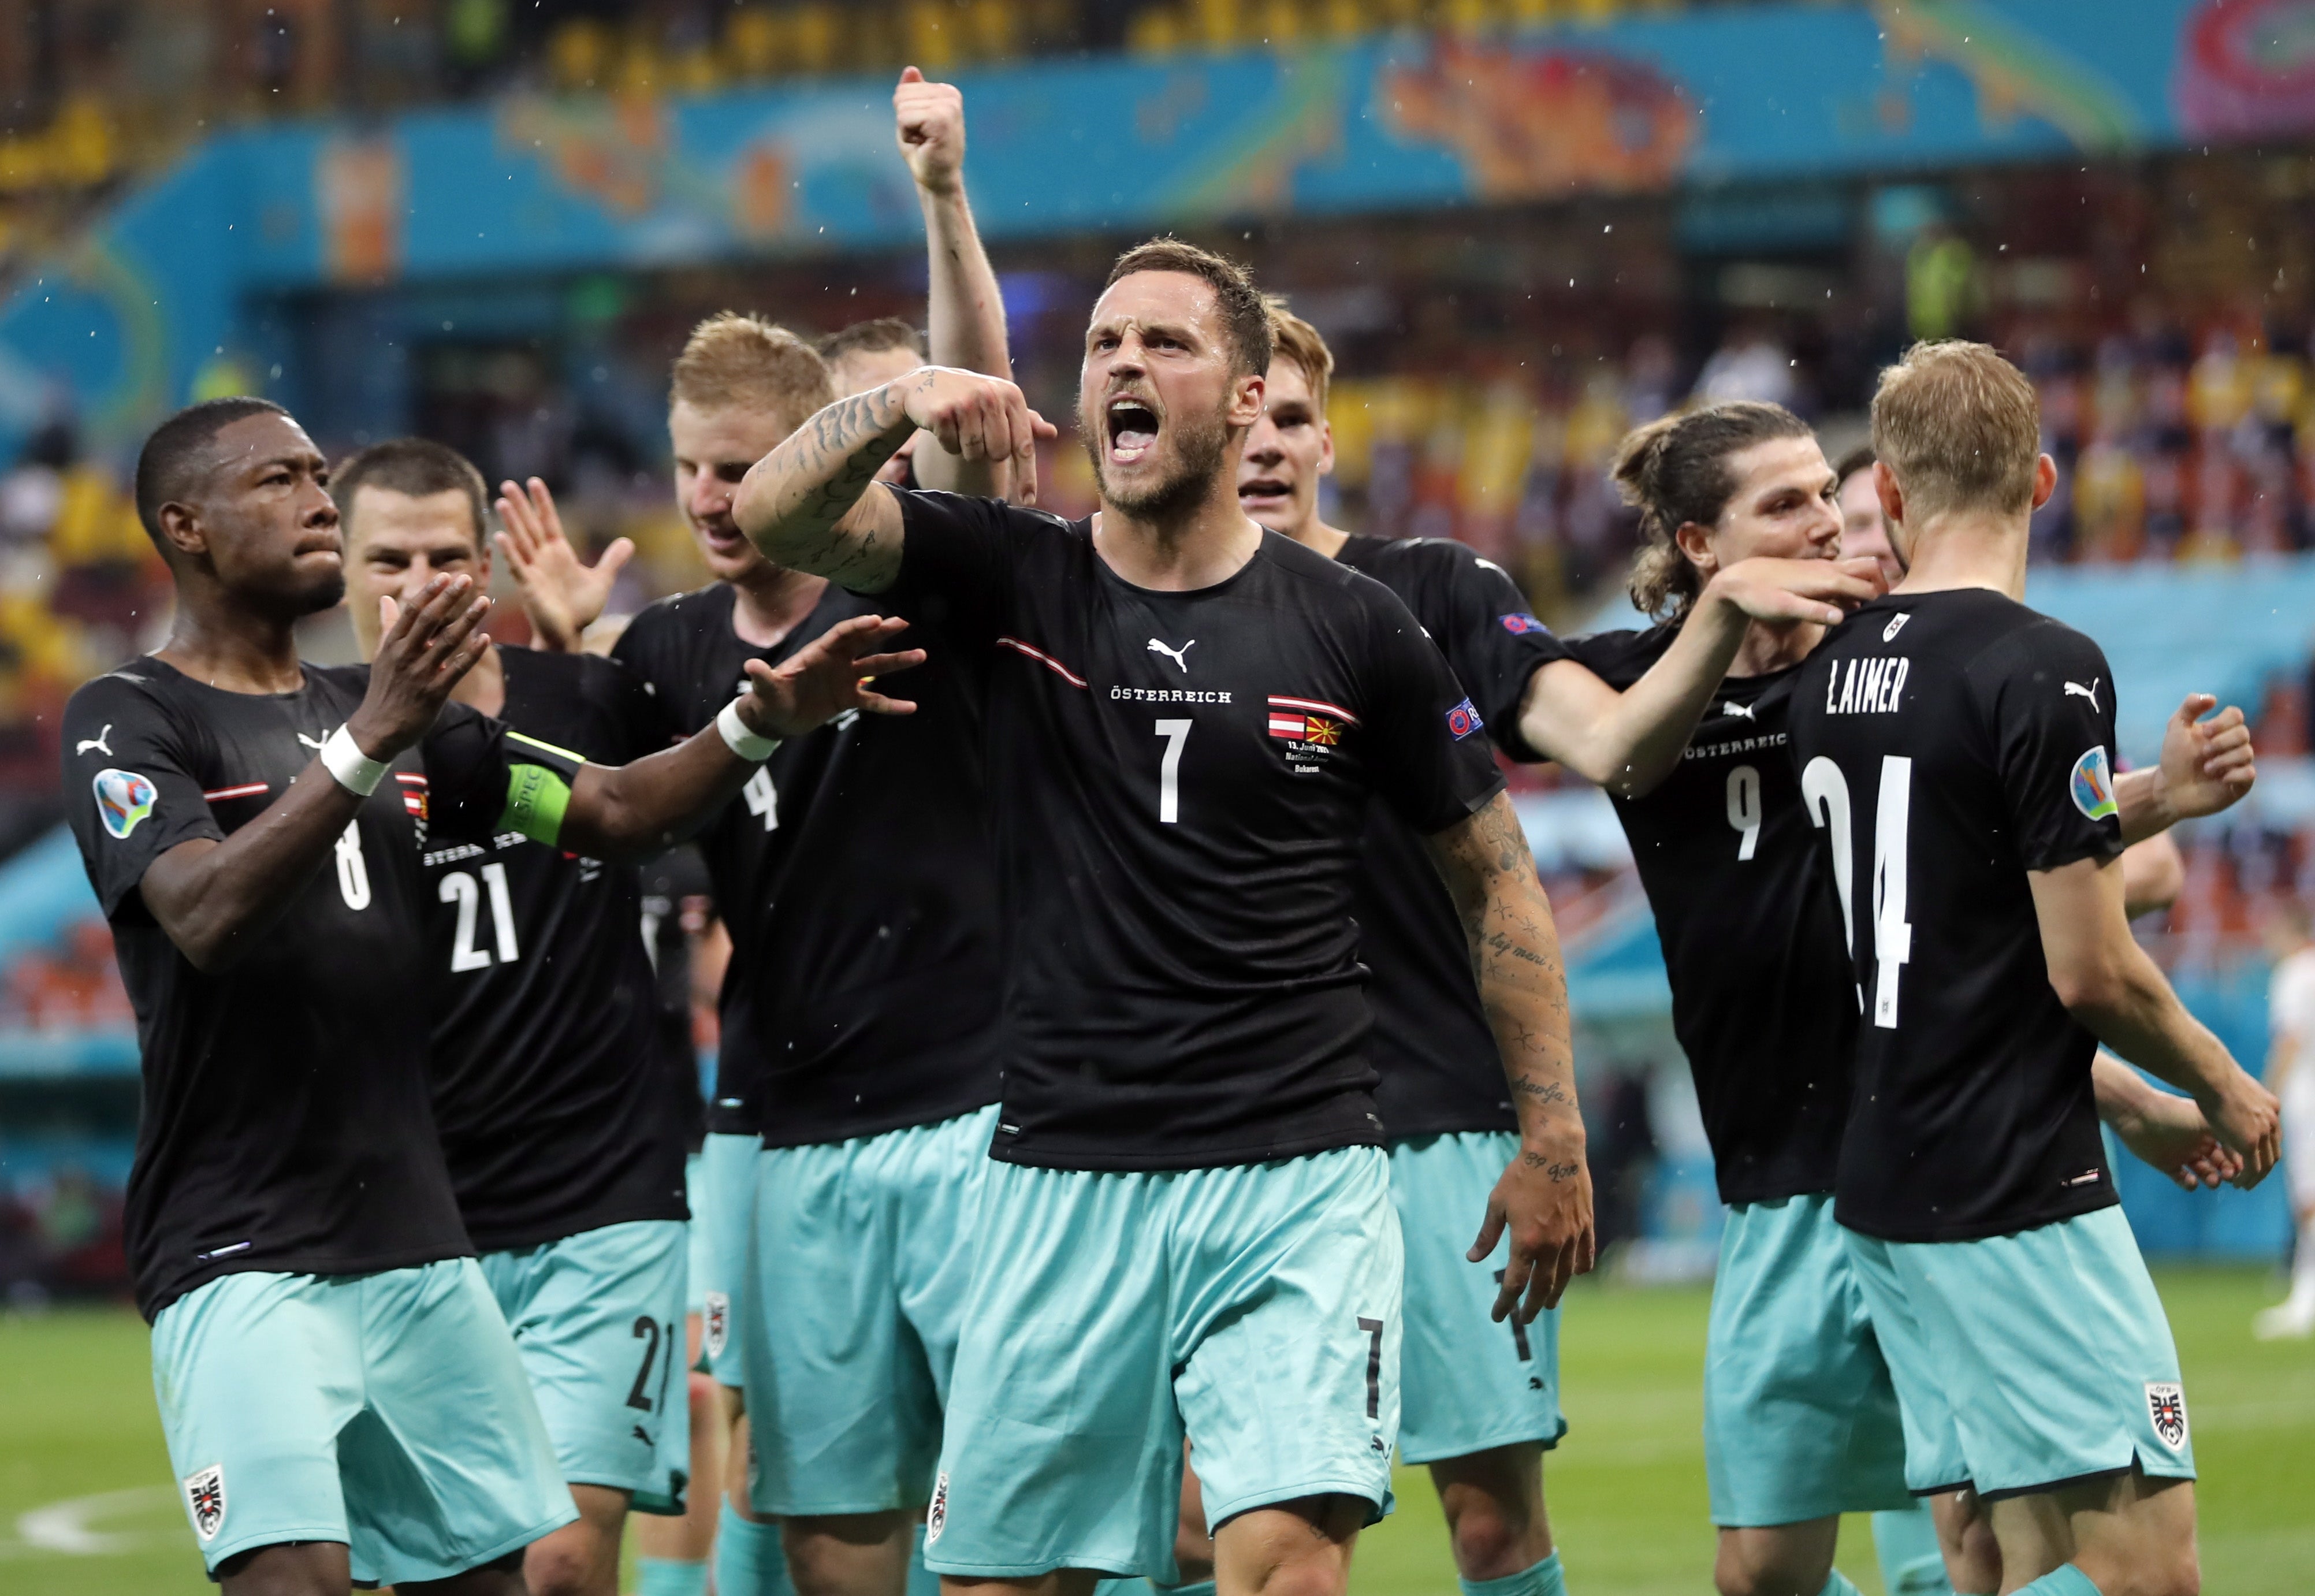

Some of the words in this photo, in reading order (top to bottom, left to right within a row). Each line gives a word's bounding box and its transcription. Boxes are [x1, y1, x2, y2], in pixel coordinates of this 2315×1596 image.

[1110, 685, 1231, 703] ÖSTERREICH
[1826, 657, 1909, 714] LAIMER
[1155, 719, 1193, 823] 7
[1300, 743, 1315, 752] Juni
[1684, 732, 1787, 760] ÖSTERREIC
[1726, 764, 1761, 861] 9
[334, 818, 371, 909] 8
[1802, 755, 1911, 1028] 24
[438, 862, 519, 973] 21
[626, 1316, 674, 1417] 21
[1357, 1316, 1383, 1419] 7
